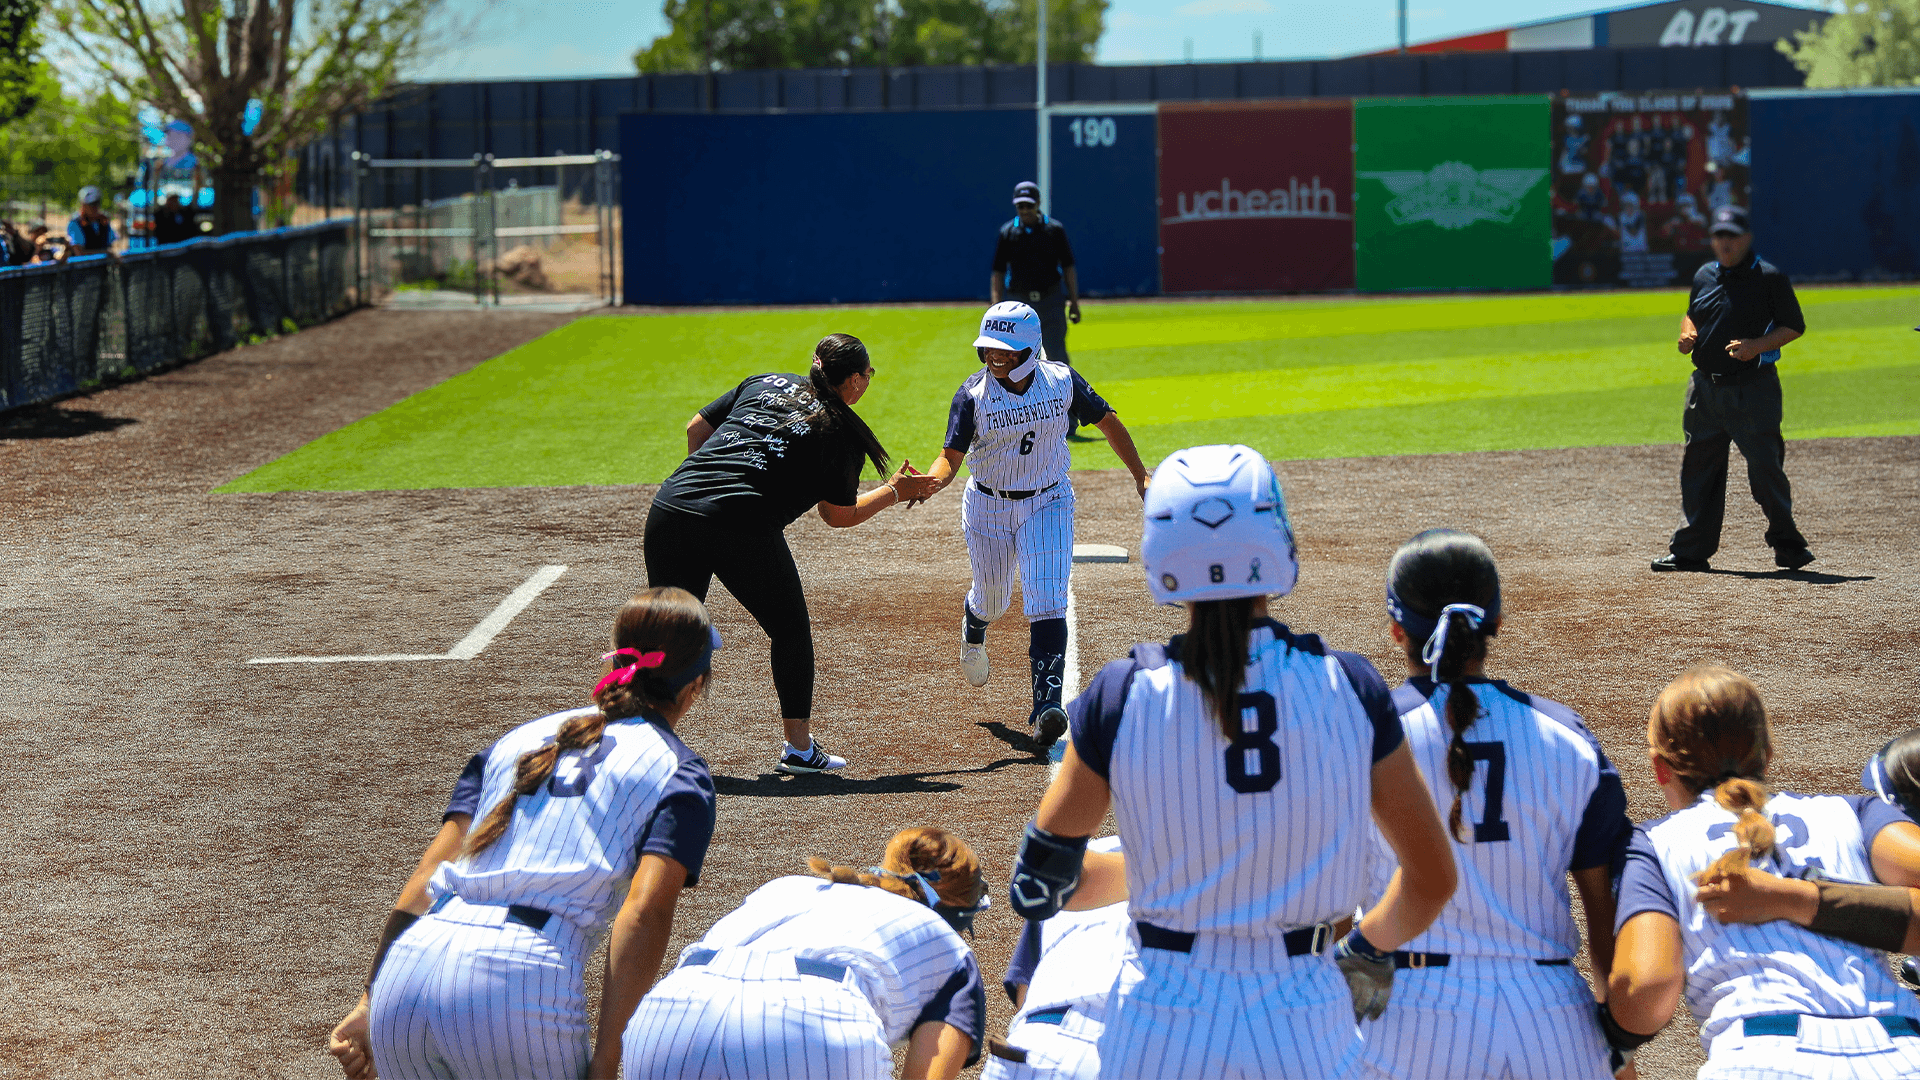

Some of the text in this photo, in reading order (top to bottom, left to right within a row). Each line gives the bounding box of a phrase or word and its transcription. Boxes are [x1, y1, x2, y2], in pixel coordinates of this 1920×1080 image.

[1659, 8, 1759, 46] ART
[1639, 96, 1677, 111] CLASS
[1681, 95, 1697, 110] OF
[1068, 117, 1117, 147] 190
[1176, 176, 1337, 217] uchealth
[984, 319, 1017, 334] PACK
[986, 398, 1064, 431] THUNDERWOLVES
[1019, 430, 1036, 456] 6
[1209, 564, 1225, 583] 8
[1225, 690, 1281, 795] 8
[1468, 741, 1511, 842] 7
